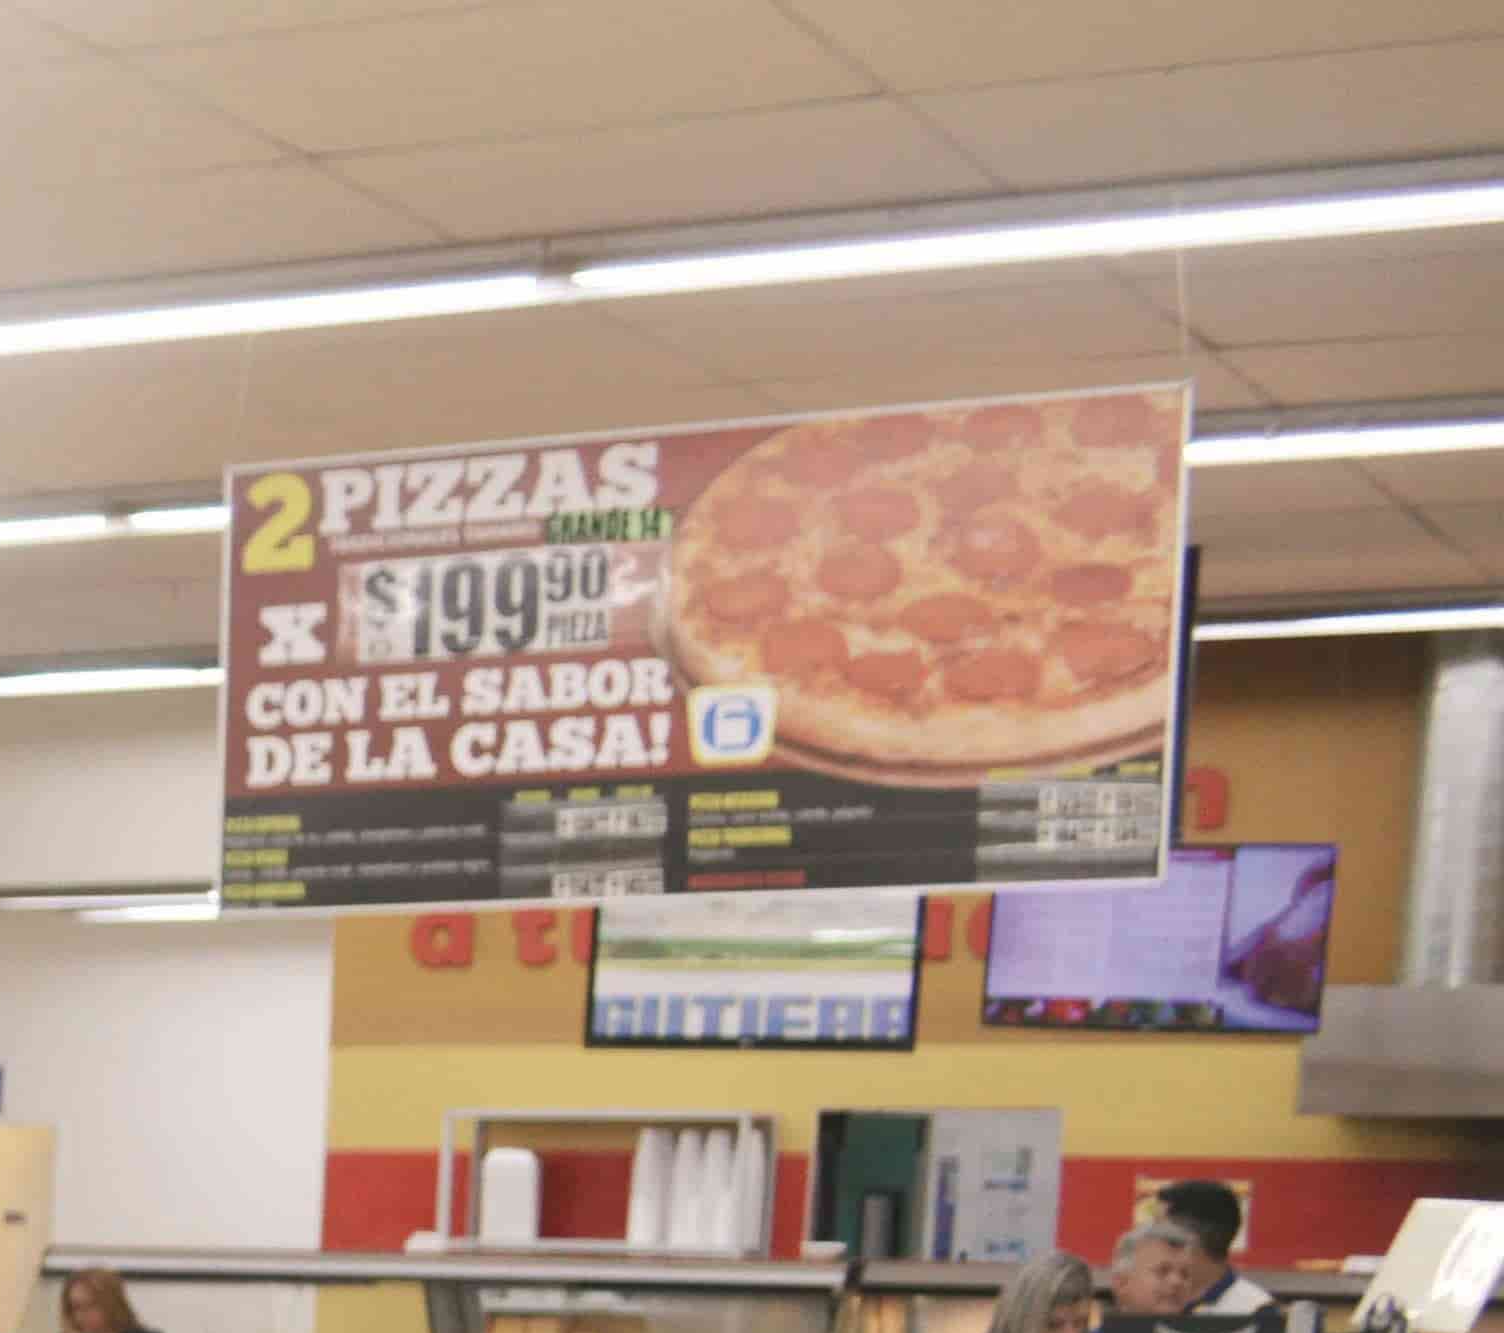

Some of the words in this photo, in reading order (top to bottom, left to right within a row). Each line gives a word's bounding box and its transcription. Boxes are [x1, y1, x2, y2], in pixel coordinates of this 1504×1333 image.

[242, 471, 316, 575] 2
[320, 441, 660, 535] PIZZAS
[546, 509, 630, 544] GRANDE
[246, 676, 369, 730] CON
[380, 672, 450, 721] EL
[461, 657, 674, 716] SABOR
[245, 730, 334, 789] DE
[346, 726, 437, 782] LA
[450, 712, 672, 778] CASA!
